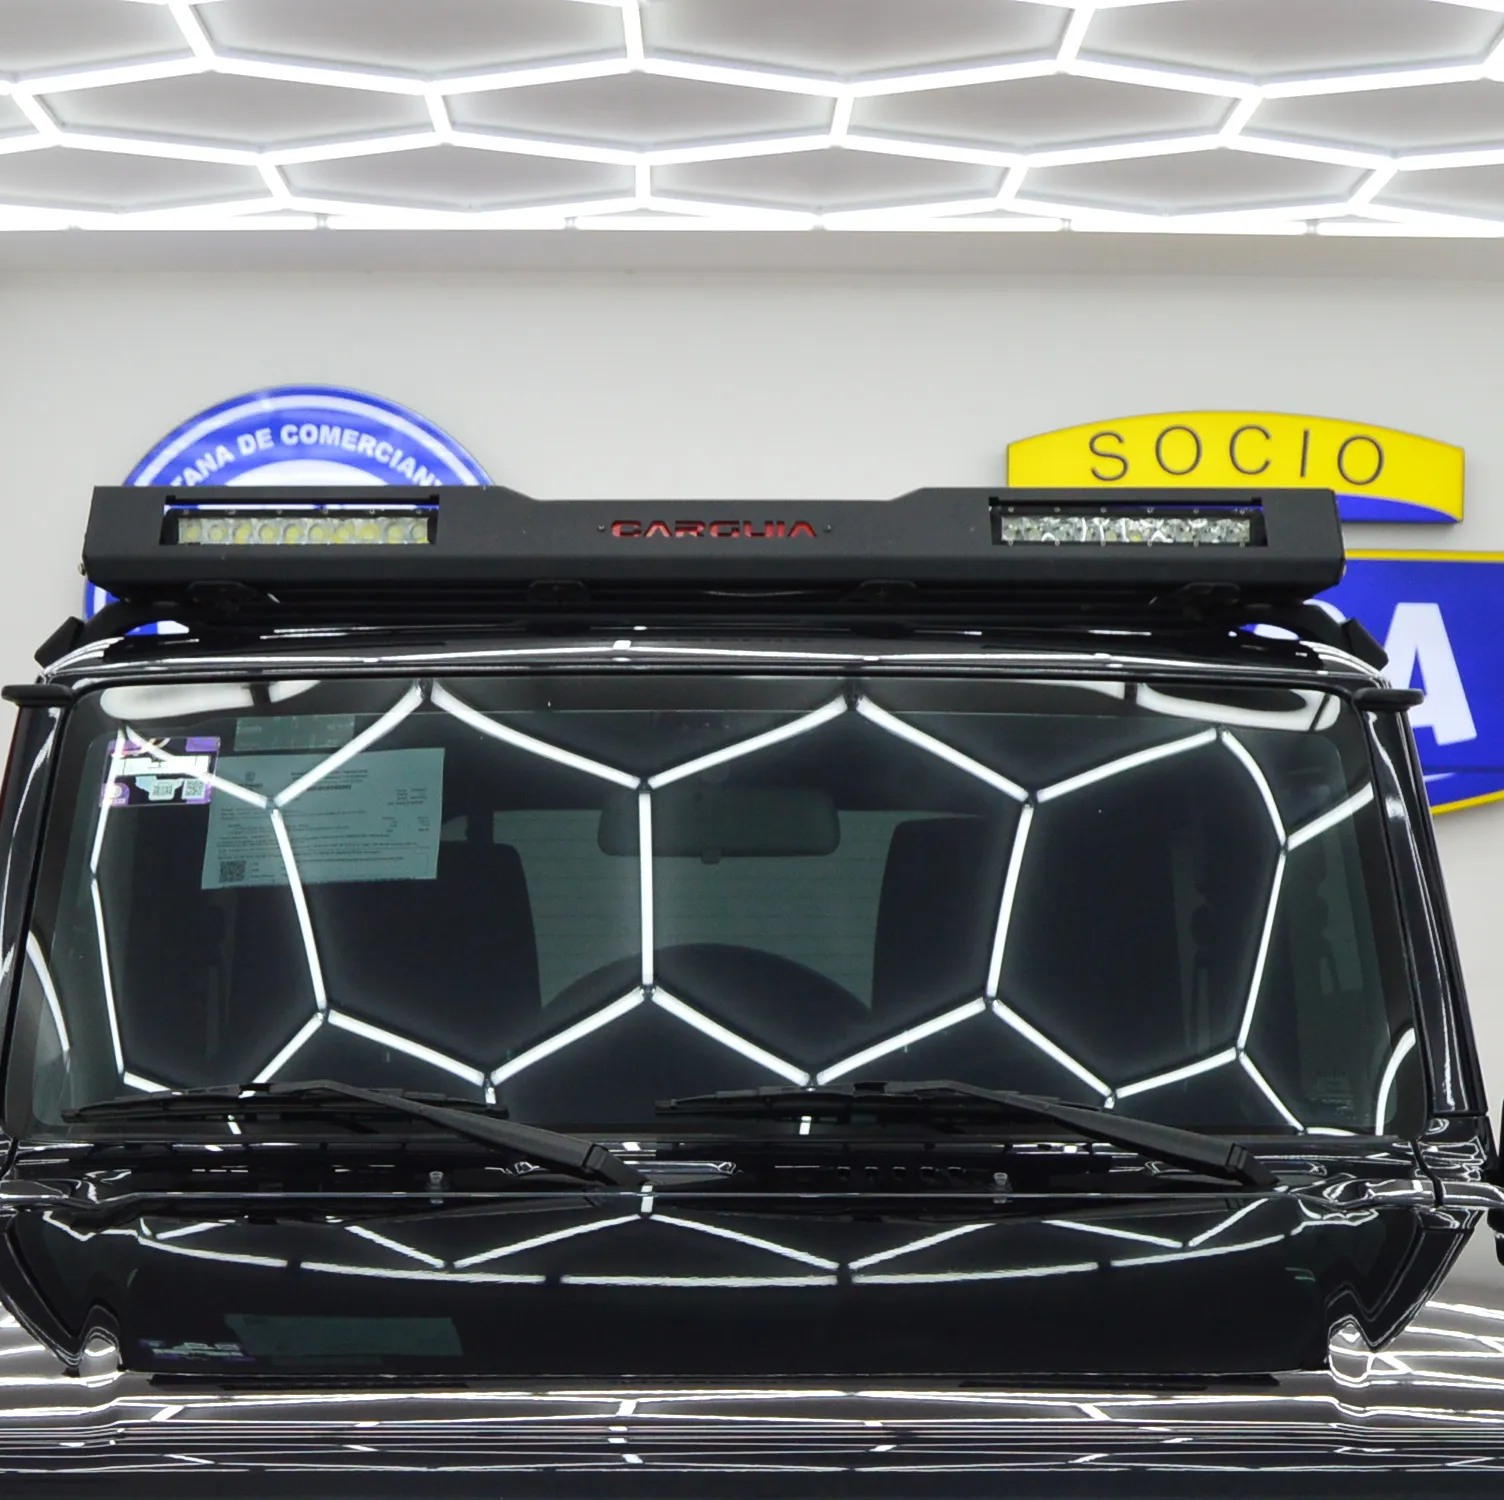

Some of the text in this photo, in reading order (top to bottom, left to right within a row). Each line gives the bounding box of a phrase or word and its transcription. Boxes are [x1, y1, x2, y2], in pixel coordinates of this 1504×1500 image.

[236, 427, 274, 457] DE
[280, 423, 443, 487] COMERCIAN
[1088, 424, 1385, 485] SOCIO
[610, 519, 818, 539] CARGUIA
